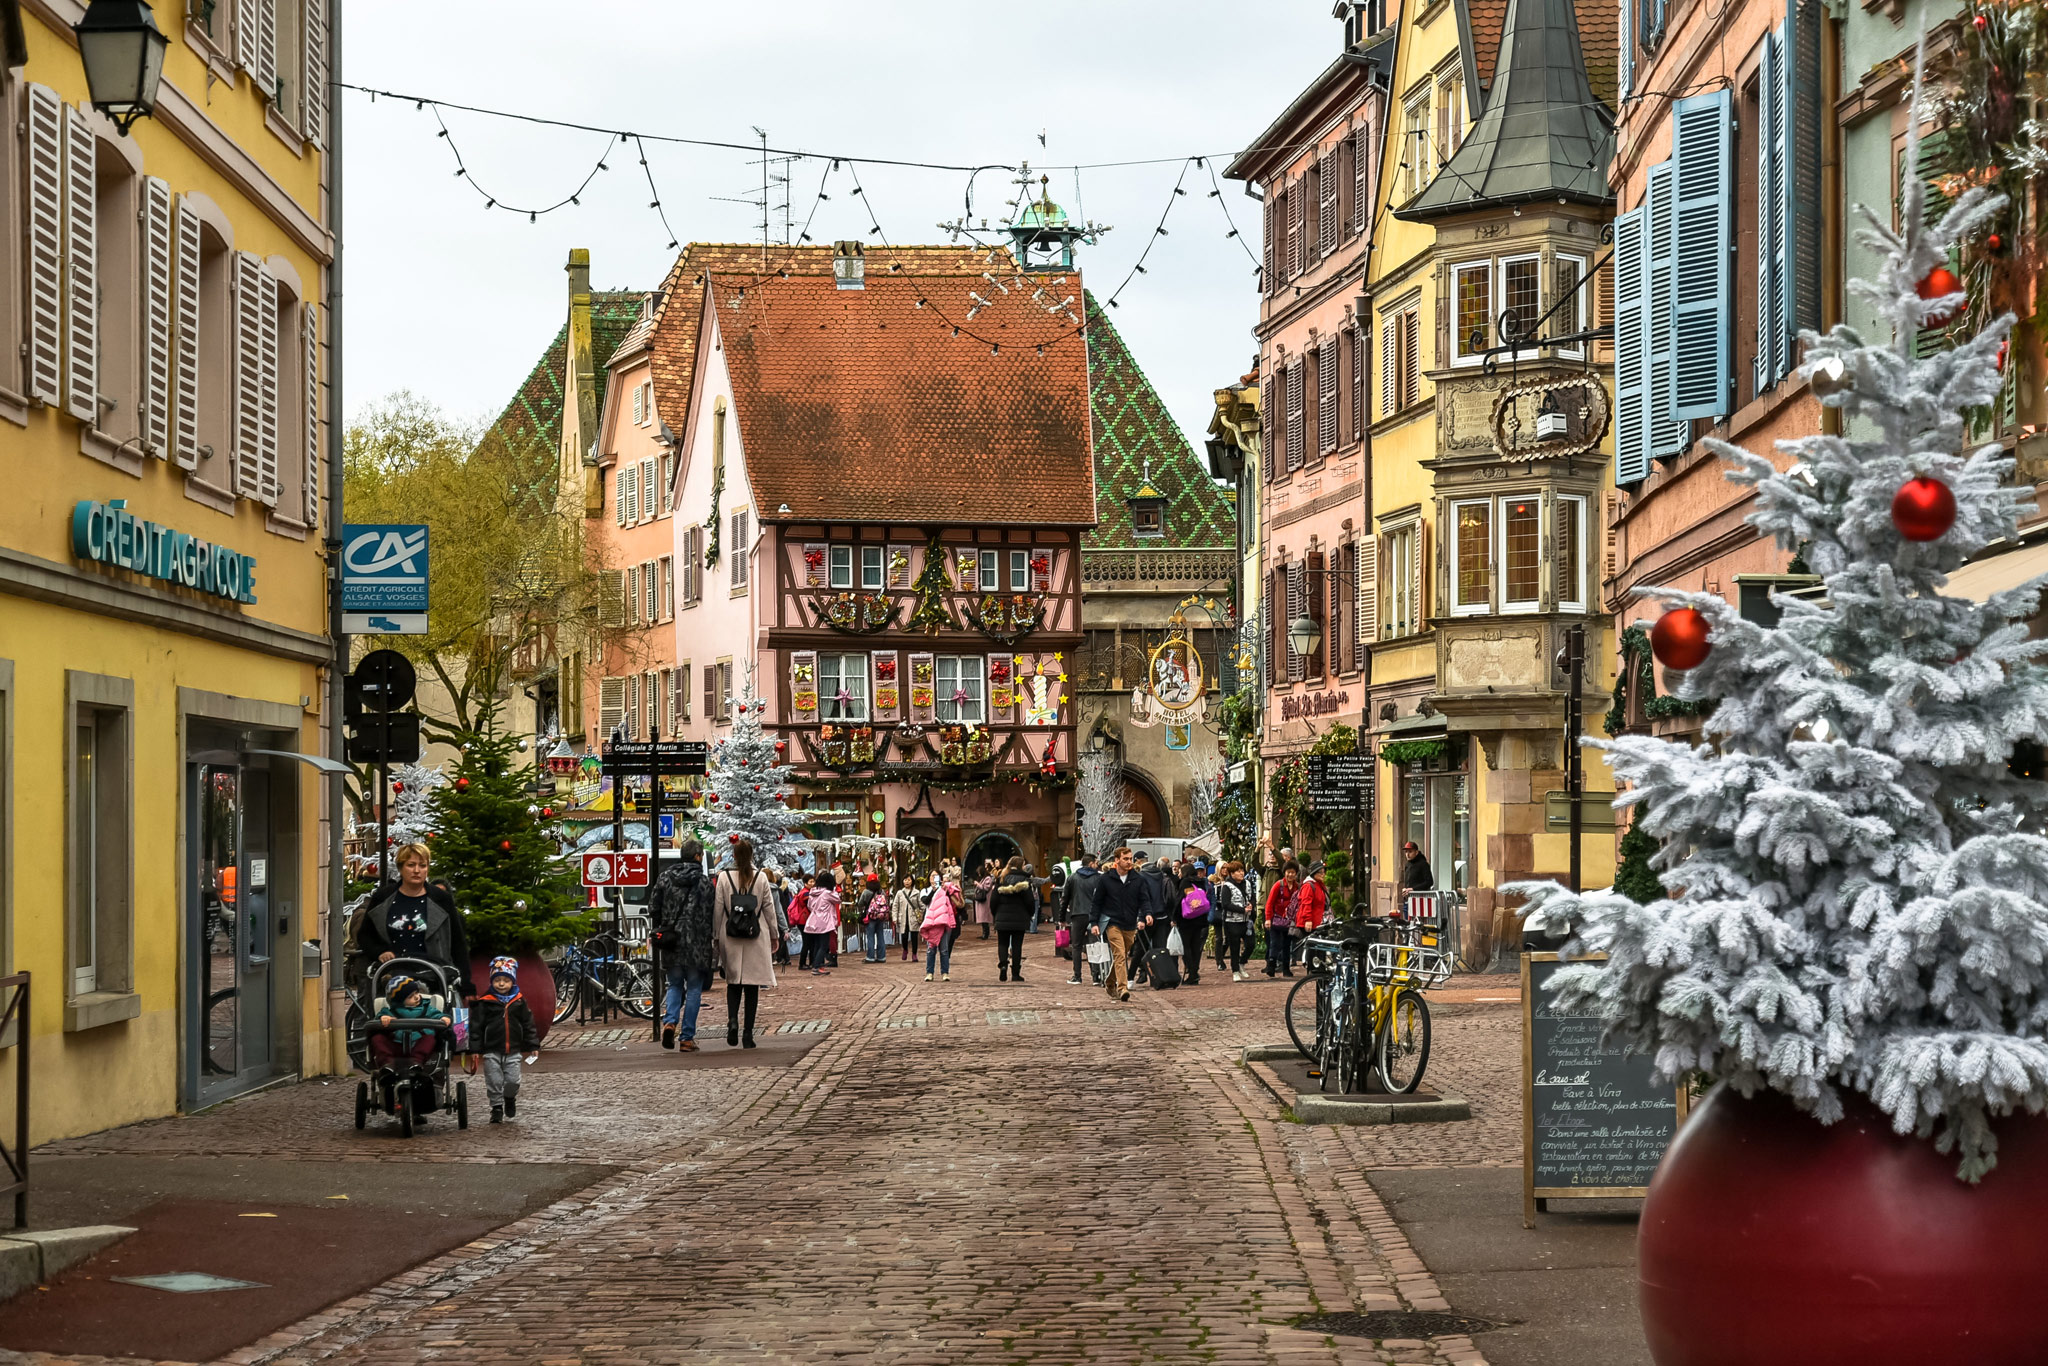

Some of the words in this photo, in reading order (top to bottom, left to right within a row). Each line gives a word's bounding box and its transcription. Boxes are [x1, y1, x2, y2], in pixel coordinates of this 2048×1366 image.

[75, 499, 167, 577] CRÉDIT
[160, 529, 257, 605] AGRICOLE
[343, 585, 377, 593] CRÉDIT
[378, 585, 425, 593] AGRICOLE
[1153, 711, 1198, 725] SAINT-MARTIN
[614, 744, 647, 754] Collégiale
[1557, 1022, 1586, 1038] Grande
[1561, 1036, 1597, 1045] salaisons
[1548, 1046, 1581, 1057] Produits
[1555, 1058, 1602, 1072] producteurs
[1549, 1070, 1590, 1085] sous-sol
[1562, 1086, 1585, 1098] Cave
[1587, 1086, 1594, 1098] à
[1599, 1082, 1622, 1098] Vins
[1551, 1100, 1572, 1110] belle
[1611, 1100, 1629, 1115] plus
[1630, 1100, 1638, 1110] de
[1547, 1127, 1574, 1138] Dans
[1590, 1126, 1609, 1138] salle
[1611, 1125, 1655, 1138] climatisée
[1656, 1125, 1668, 1137] et
[1584, 1142, 1598, 1150] un
[1627, 1139, 1634, 1149] à
[1635, 1139, 1655, 1149] Vins
[1541, 1150, 1591, 1161] restauration
[1592, 1153, 1603, 1161] en
[1605, 1150, 1634, 1161] continu
[1638, 1150, 1648, 1161] de
[1610, 1165, 1633, 1177] pause
[1570, 1172, 1580, 1185] à
[1580, 1175, 1600, 1184] vous
[1601, 1173, 1612, 1184] de
